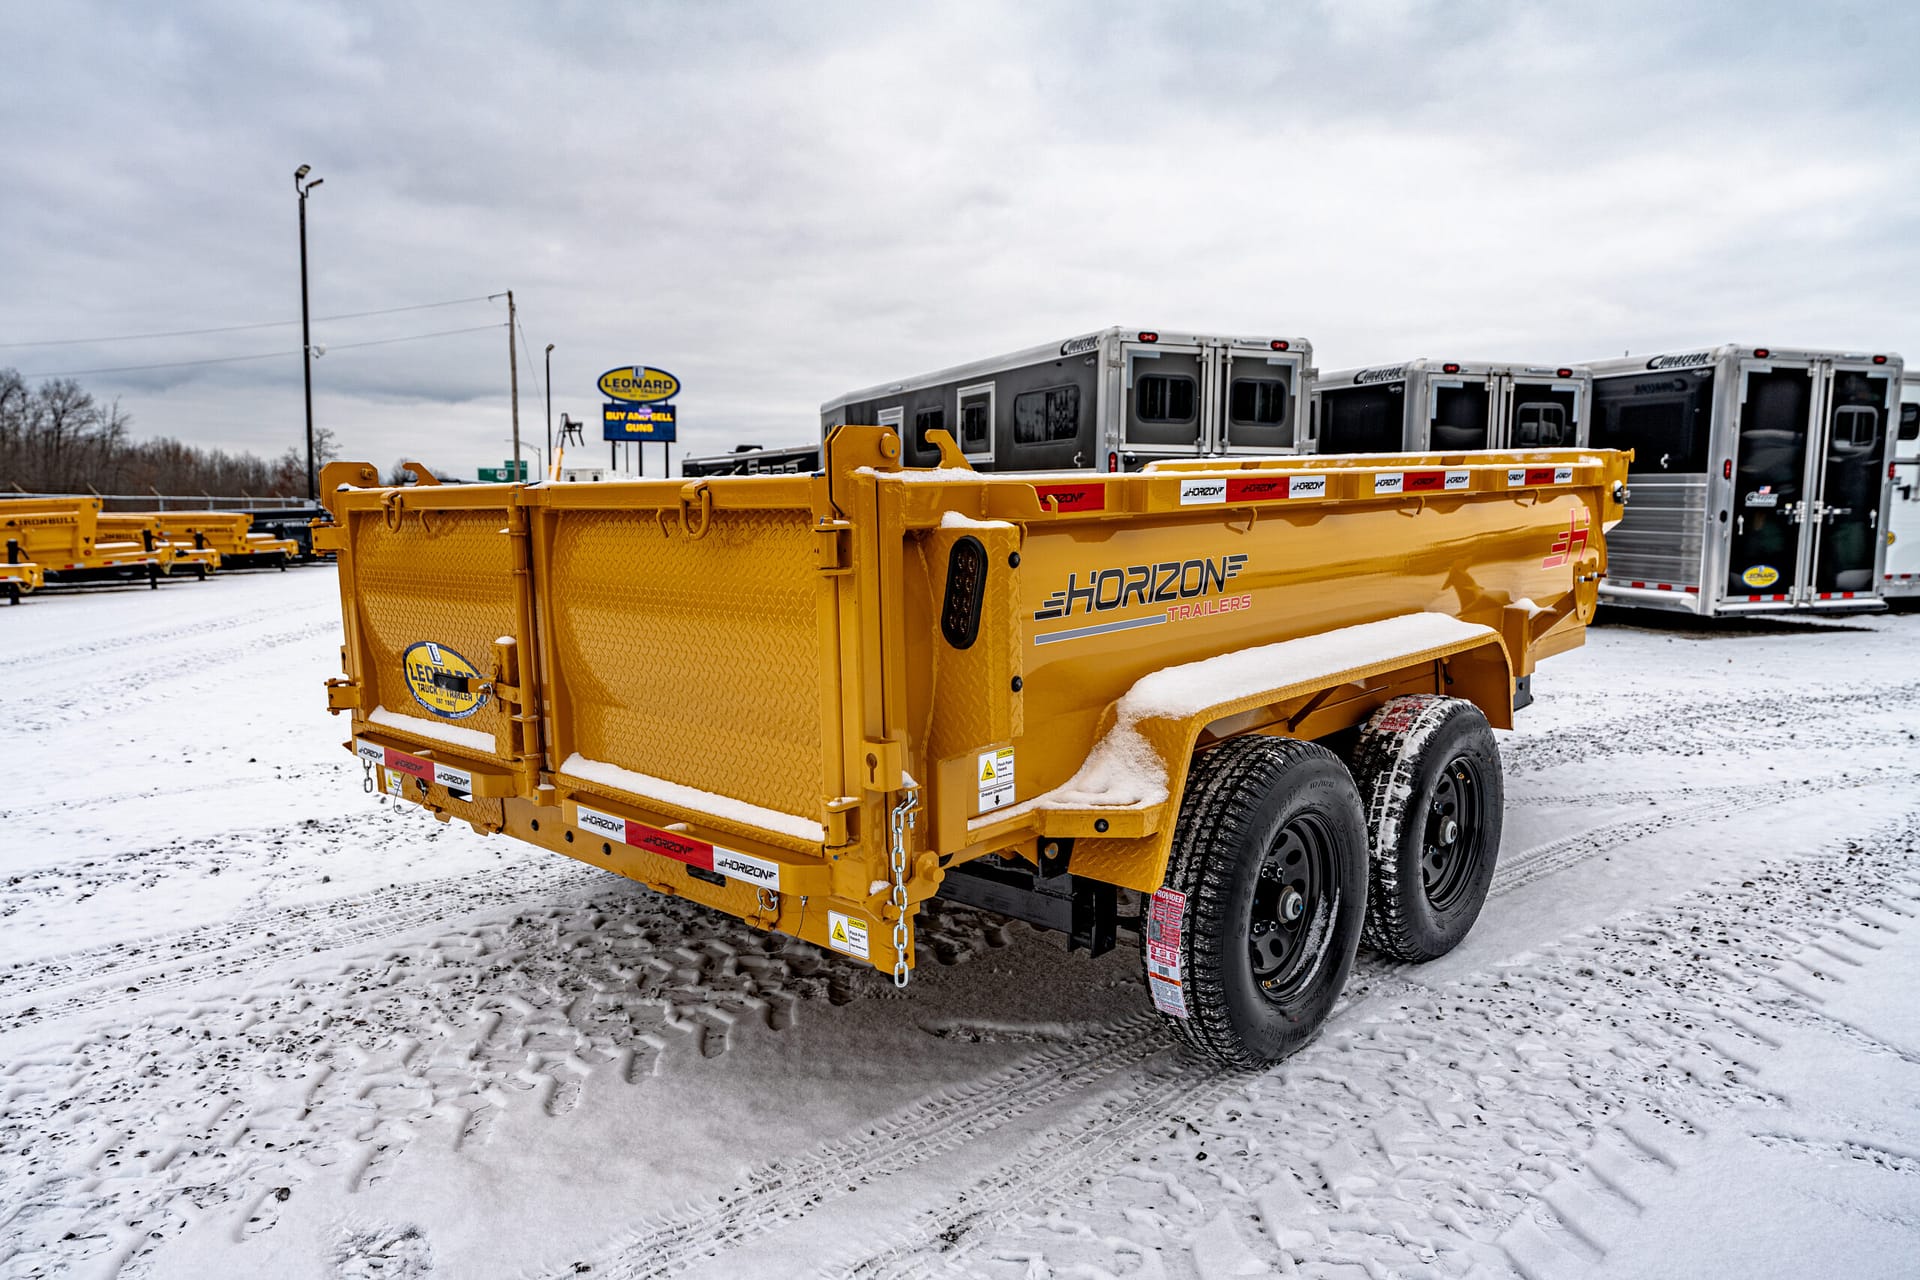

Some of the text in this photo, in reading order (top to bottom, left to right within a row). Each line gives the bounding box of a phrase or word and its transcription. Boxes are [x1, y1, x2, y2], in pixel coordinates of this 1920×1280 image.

[604, 378, 673, 389] LEONARD
[605, 411, 626, 420] BUY
[650, 413, 673, 421] SELL
[625, 423, 654, 432] GUNS
[1183, 486, 1224, 496] HORIZON
[1292, 481, 1324, 490] HORIZON
[19, 516, 78, 526] IRONBULL
[1063, 556, 1232, 617] HORIZON
[1167, 594, 1251, 621] TRAILERS
[417, 682, 438, 695] TRUCK
[359, 746, 383, 759] HORIZON
[437, 771, 469, 786] HORIZON
[580, 814, 776, 880] HORIZON HORIZON HORIZON
